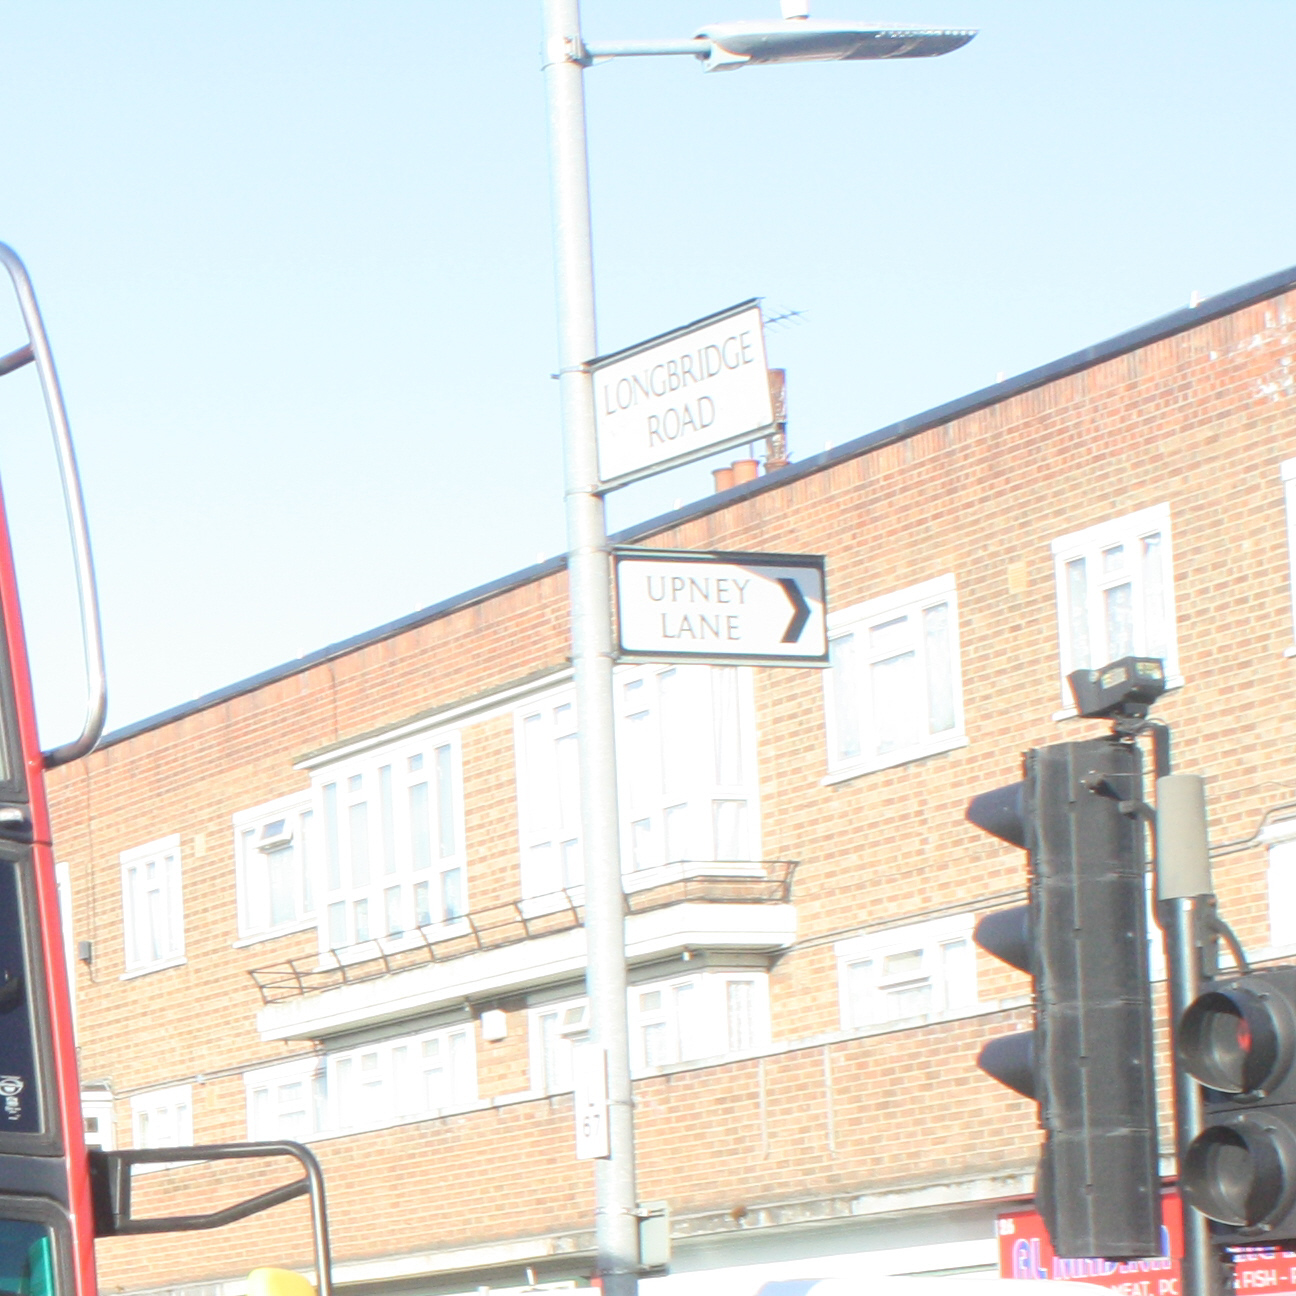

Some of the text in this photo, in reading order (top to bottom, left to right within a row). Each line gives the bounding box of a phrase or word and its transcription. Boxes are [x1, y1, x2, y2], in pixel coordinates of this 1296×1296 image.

[602, 331, 754, 416] LONGBRIDGE
[647, 395, 716, 448] ROAD
[645, 574, 752, 605] UPNEY
[660, 613, 742, 641] LANE
[1242, 1269, 1278, 1289] FISH
